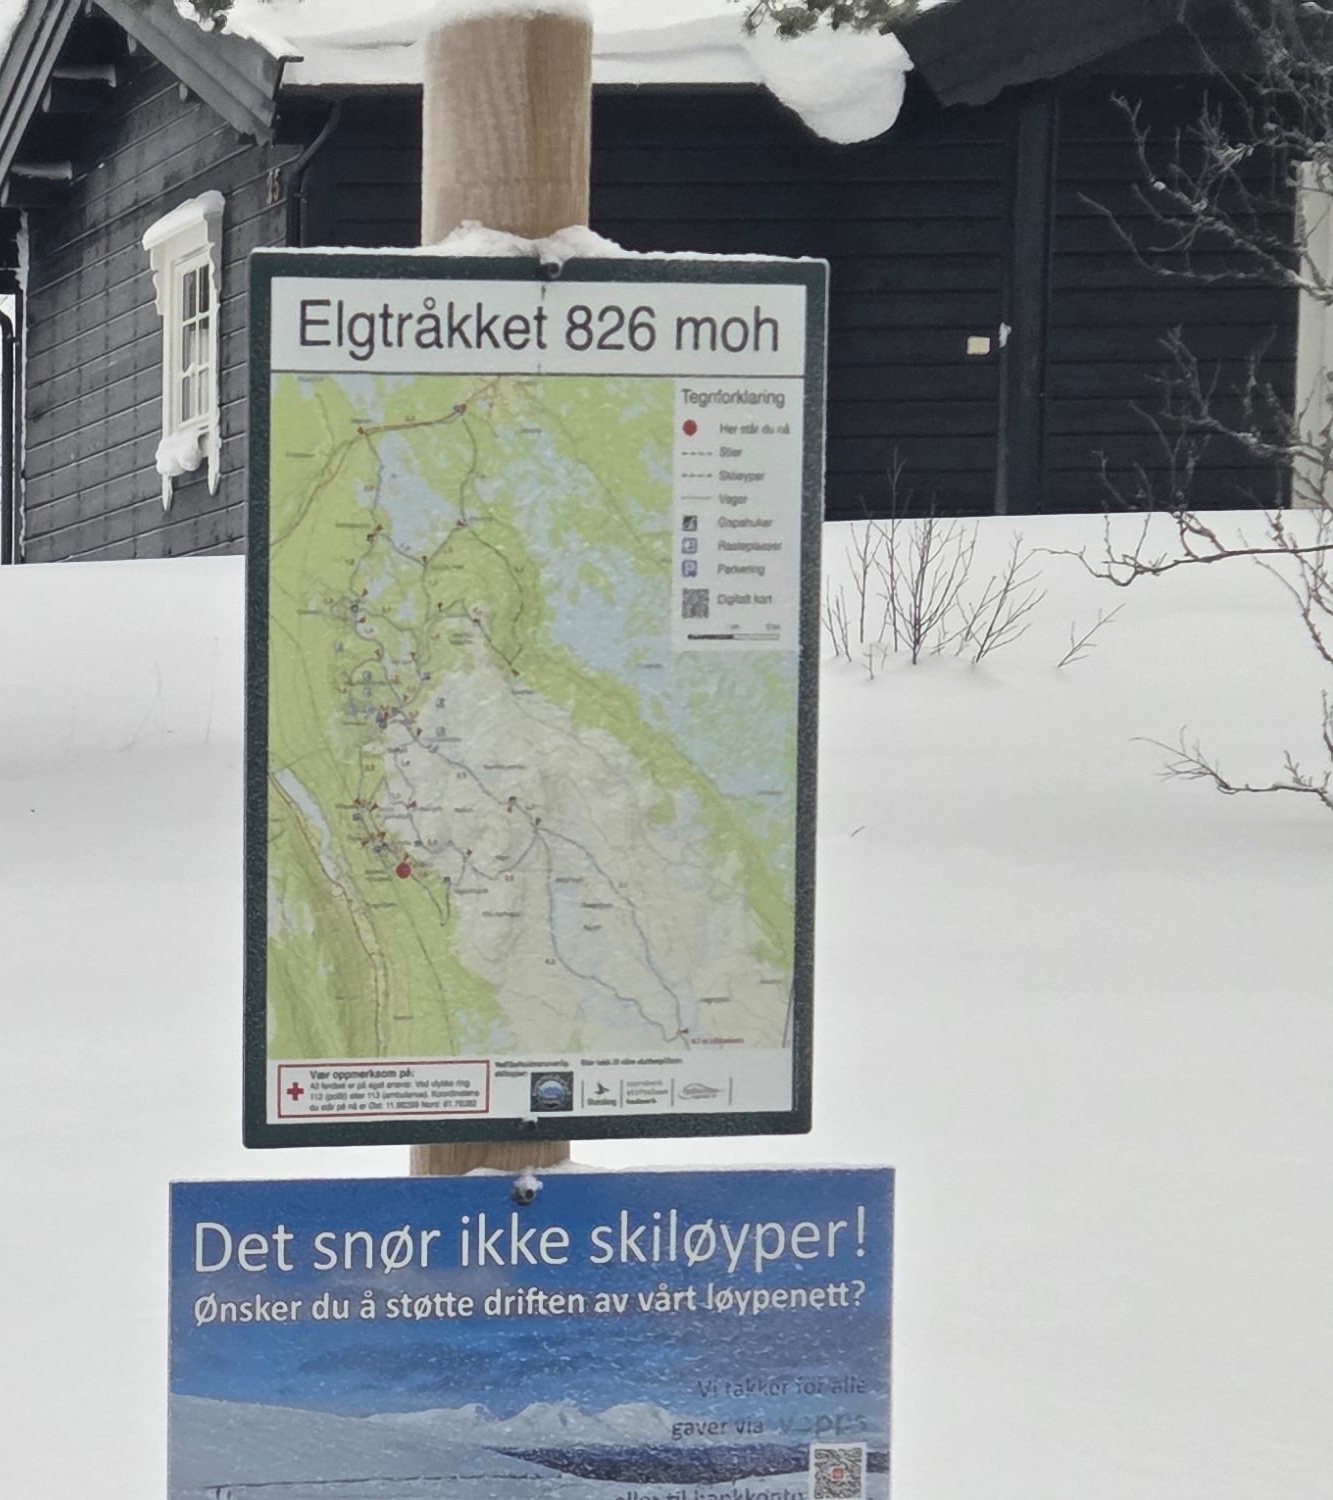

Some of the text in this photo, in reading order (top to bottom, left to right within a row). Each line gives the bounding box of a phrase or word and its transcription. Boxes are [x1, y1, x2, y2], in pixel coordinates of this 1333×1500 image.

[298, 296, 780, 362] Elgtråkket 826 moh
[681, 388, 786, 409] Tegnforklaring
[194, 1205, 866, 1275] Det snør ikke skiløyper!
[193, 1279, 867, 1327] Ønsker du å støtte driften av vårt løypenett?
[670, 1420, 729, 1441] gaver
[735, 1418, 765, 1435] via
